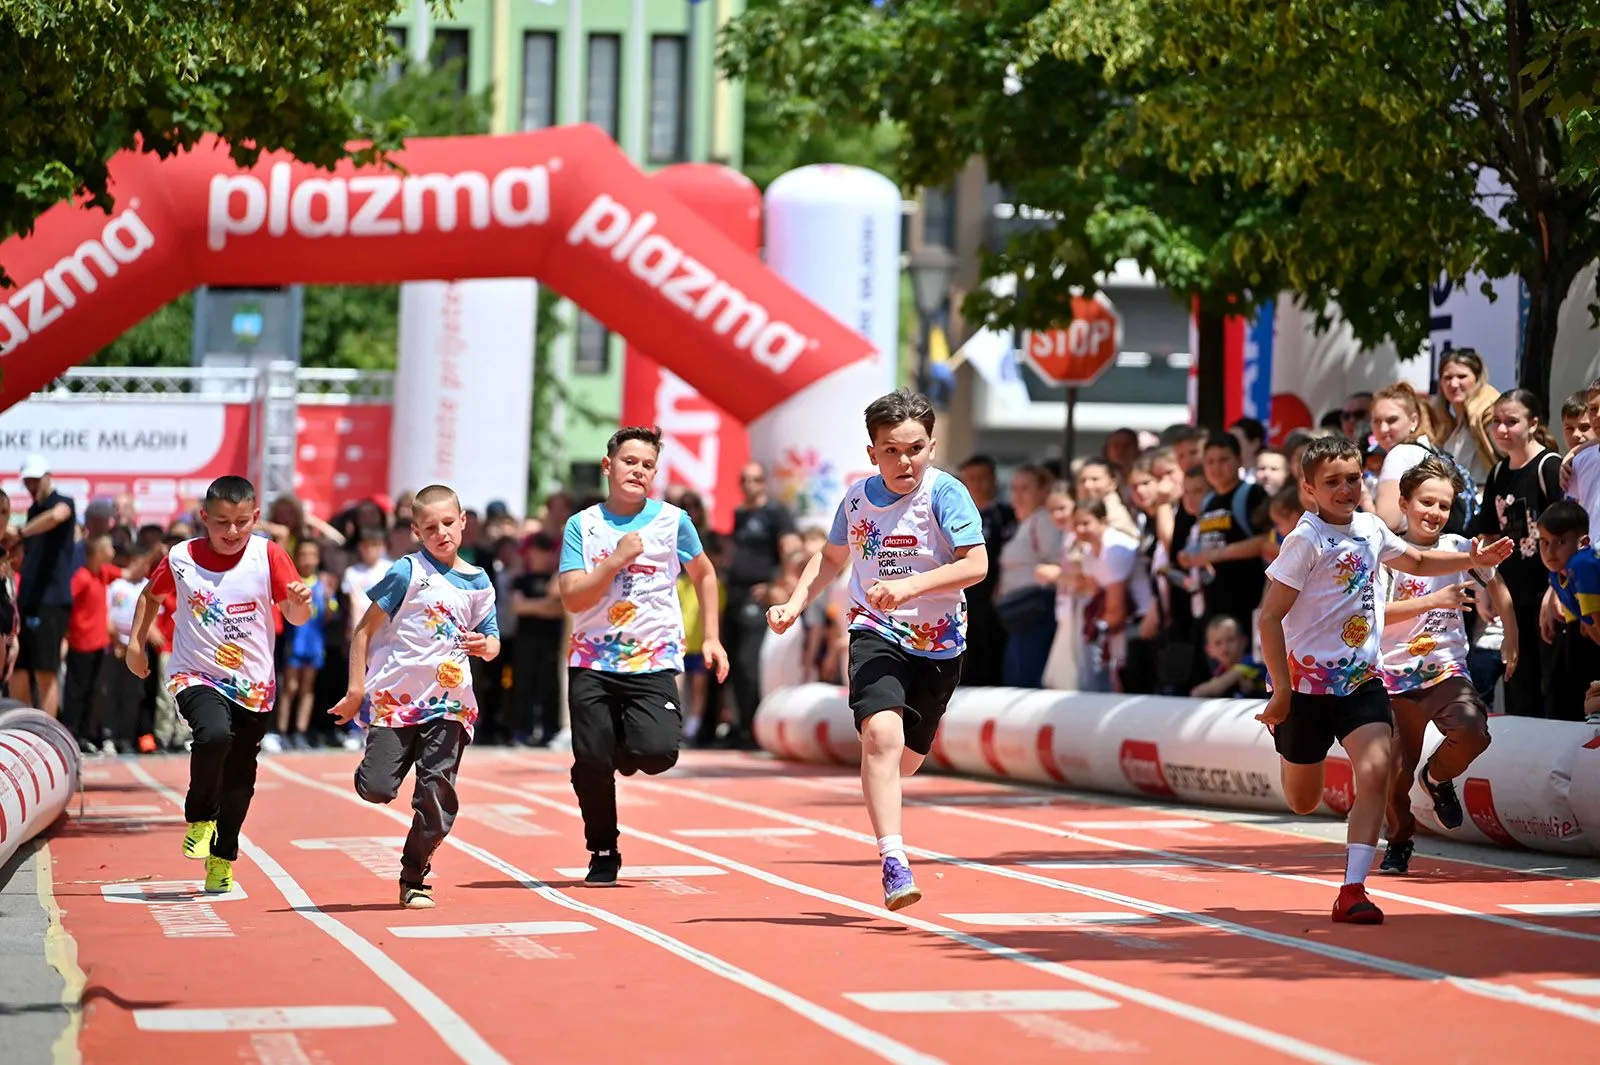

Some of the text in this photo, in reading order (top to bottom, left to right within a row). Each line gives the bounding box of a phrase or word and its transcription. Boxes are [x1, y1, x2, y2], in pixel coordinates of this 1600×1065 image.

[207, 161, 551, 251] plazma
[566, 193, 807, 374] plazma
[40, 430, 90, 448] IGRE
[98, 430, 188, 450] MLADIH
[884, 537, 914, 547] plazma
[877, 550, 919, 558] SPORTSKE
[878, 566, 912, 577] MLADIH
